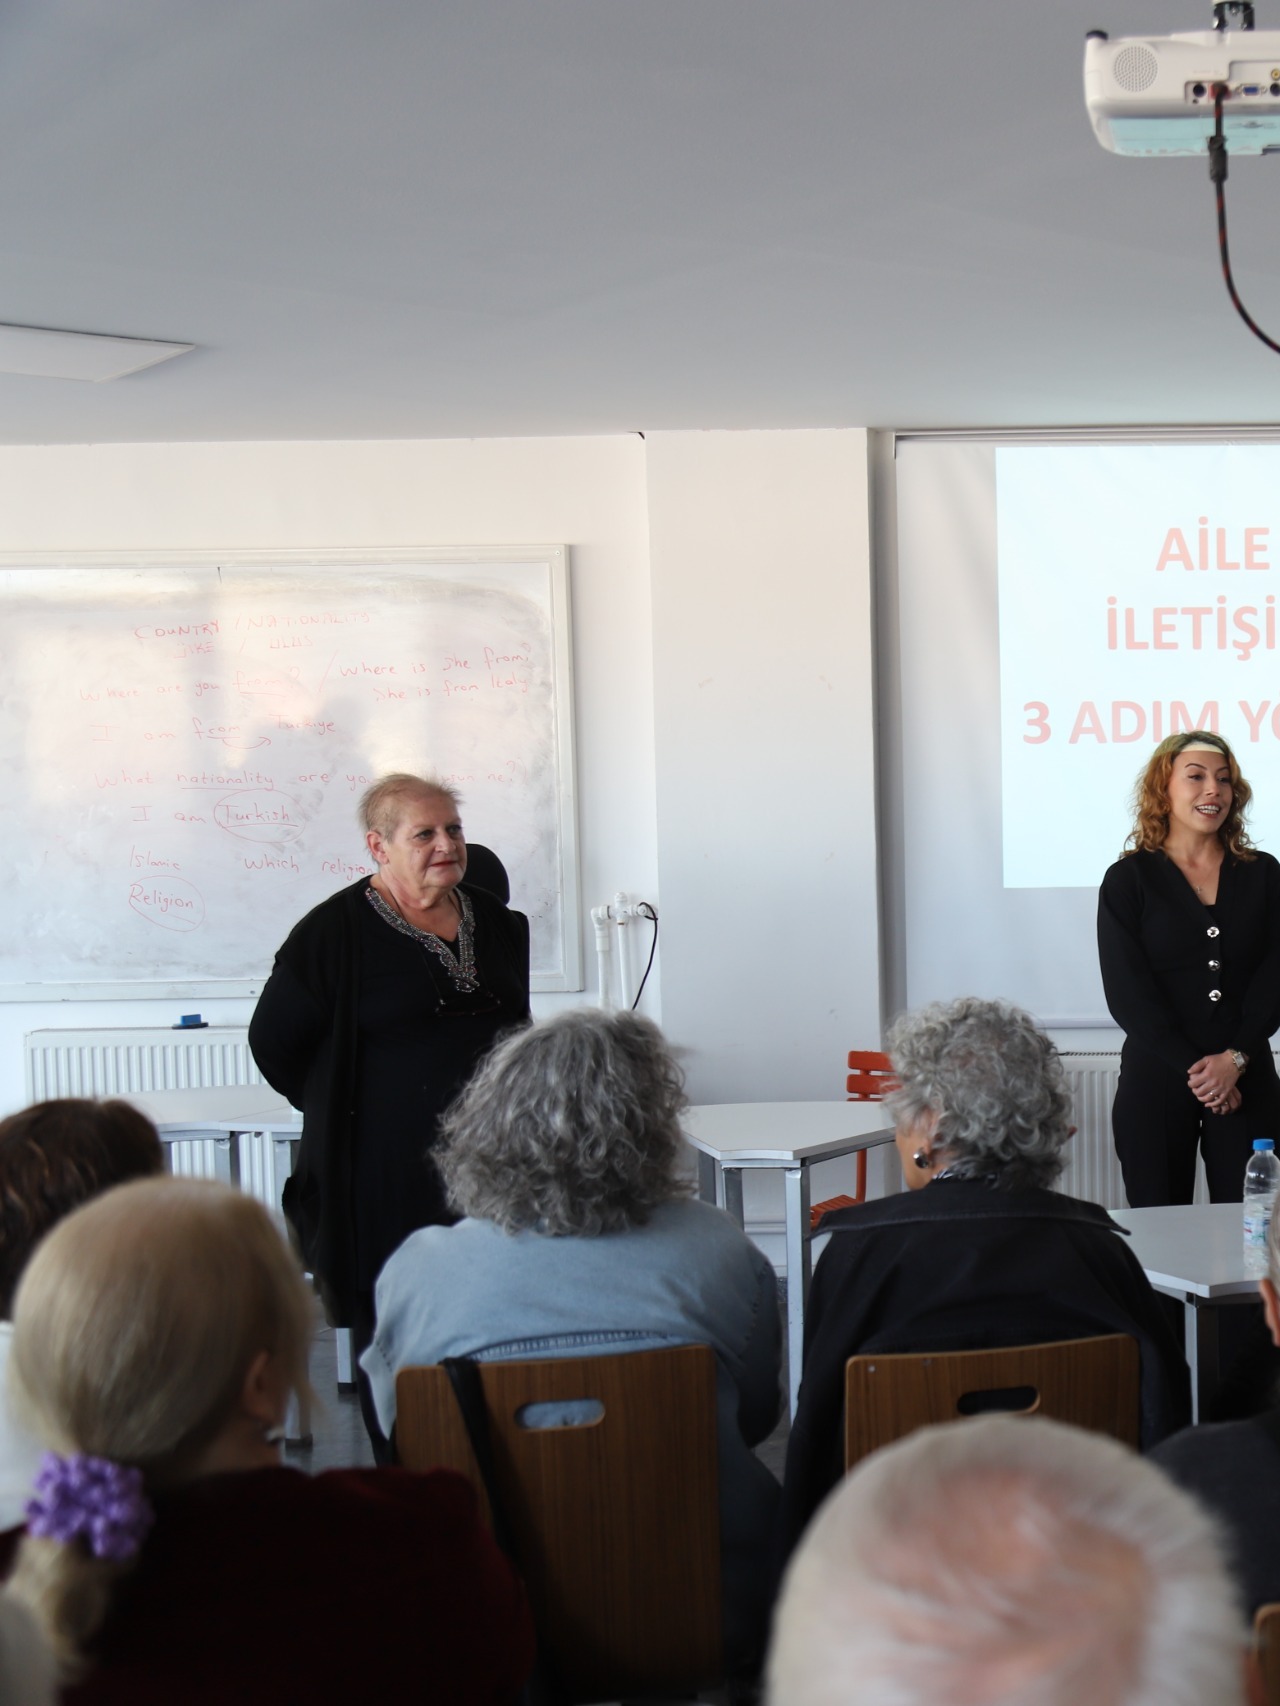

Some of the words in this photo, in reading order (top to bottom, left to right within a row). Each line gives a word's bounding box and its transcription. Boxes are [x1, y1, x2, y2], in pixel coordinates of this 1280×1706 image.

[1155, 516, 1270, 572] AİLE
[134, 619, 220, 639] COUNTRY
[412, 663, 426, 673] is
[156, 685, 183, 694] are
[195, 682, 220, 697] you
[418, 688, 431, 697] is
[443, 680, 479, 697] from
[192, 717, 241, 740] from
[1022, 700, 1051, 744] 3
[1068, 700, 1219, 744] ADIM
[95, 769, 153, 788] What
[176, 771, 274, 791] nationality
[299, 772, 330, 783] are
[174, 812, 206, 823] am
[217, 802, 290, 824] Turkish
[129, 884, 194, 912] Religion
